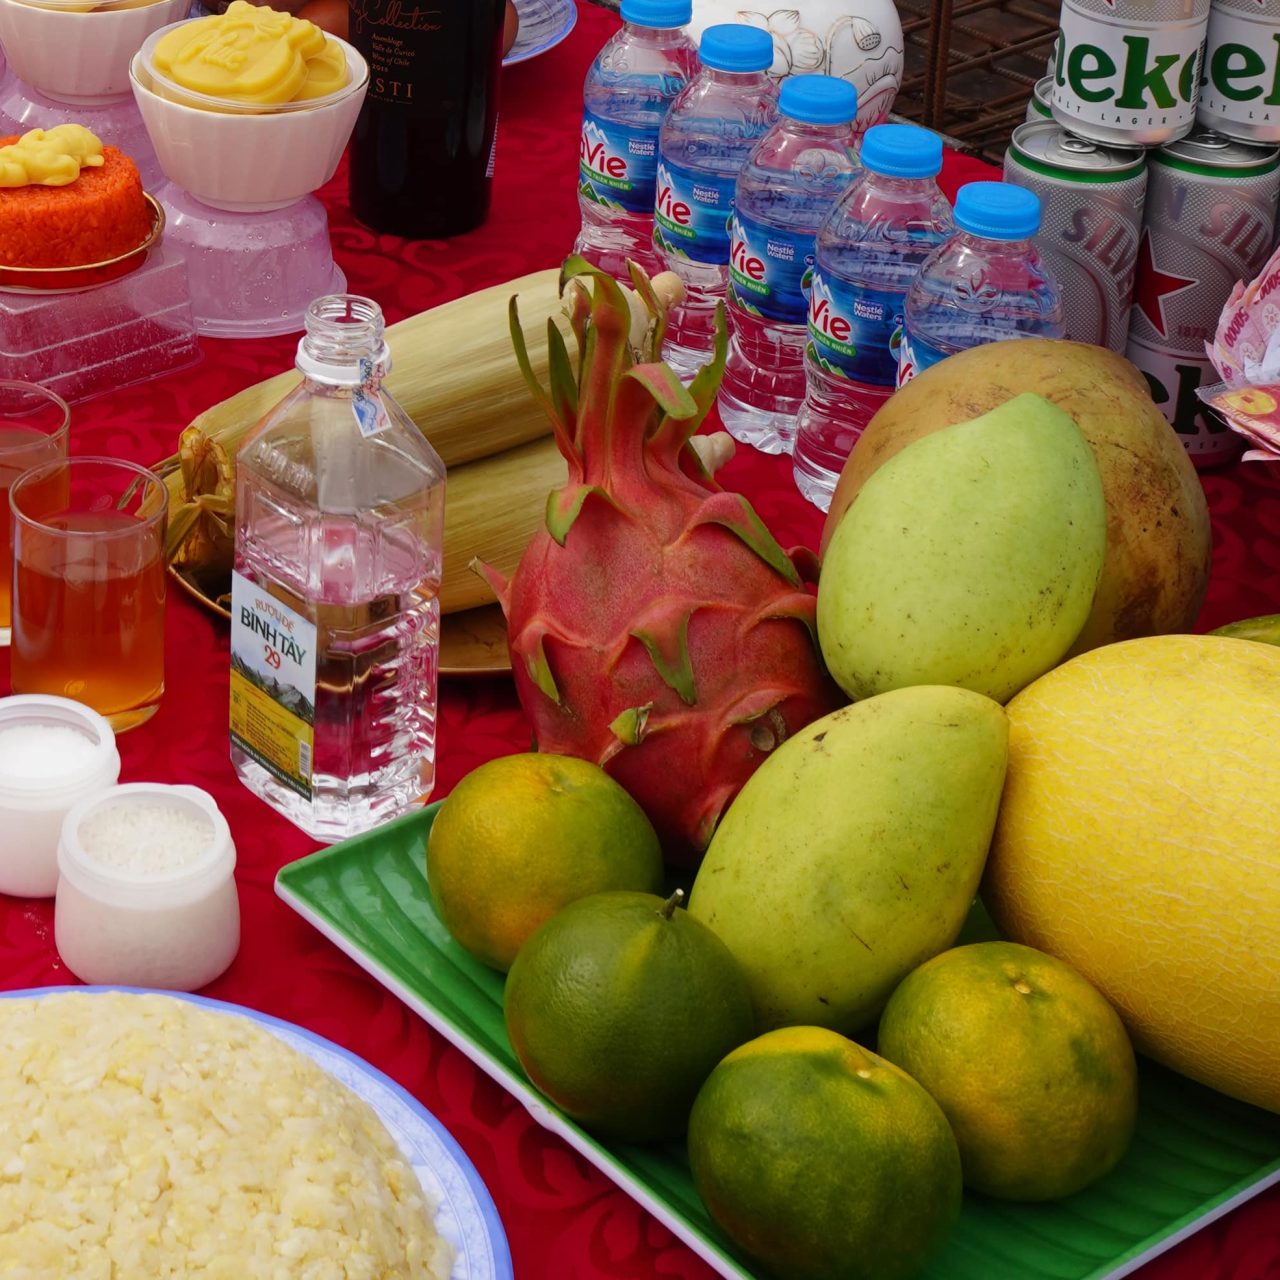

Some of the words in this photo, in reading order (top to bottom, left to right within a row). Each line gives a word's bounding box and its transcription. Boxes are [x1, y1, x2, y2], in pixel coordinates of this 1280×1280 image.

[368, 77, 413, 99] STI
[1100, 112, 1167, 125] LAGER
[629, 141, 656, 151] Nestlé
[629, 148, 655, 157] Waters
[693, 187, 719, 199] Nestlé
[693, 194, 719, 205] Waters
[768, 243, 795, 255] Nestlé
[768, 250, 794, 261] Waters
[853, 303, 883, 315] Nestlé
[853, 309, 882, 321] Waters
[240, 604, 278, 647] BÌNH
[278, 632, 307, 667] TÂY
[264, 644, 281, 670] 29
